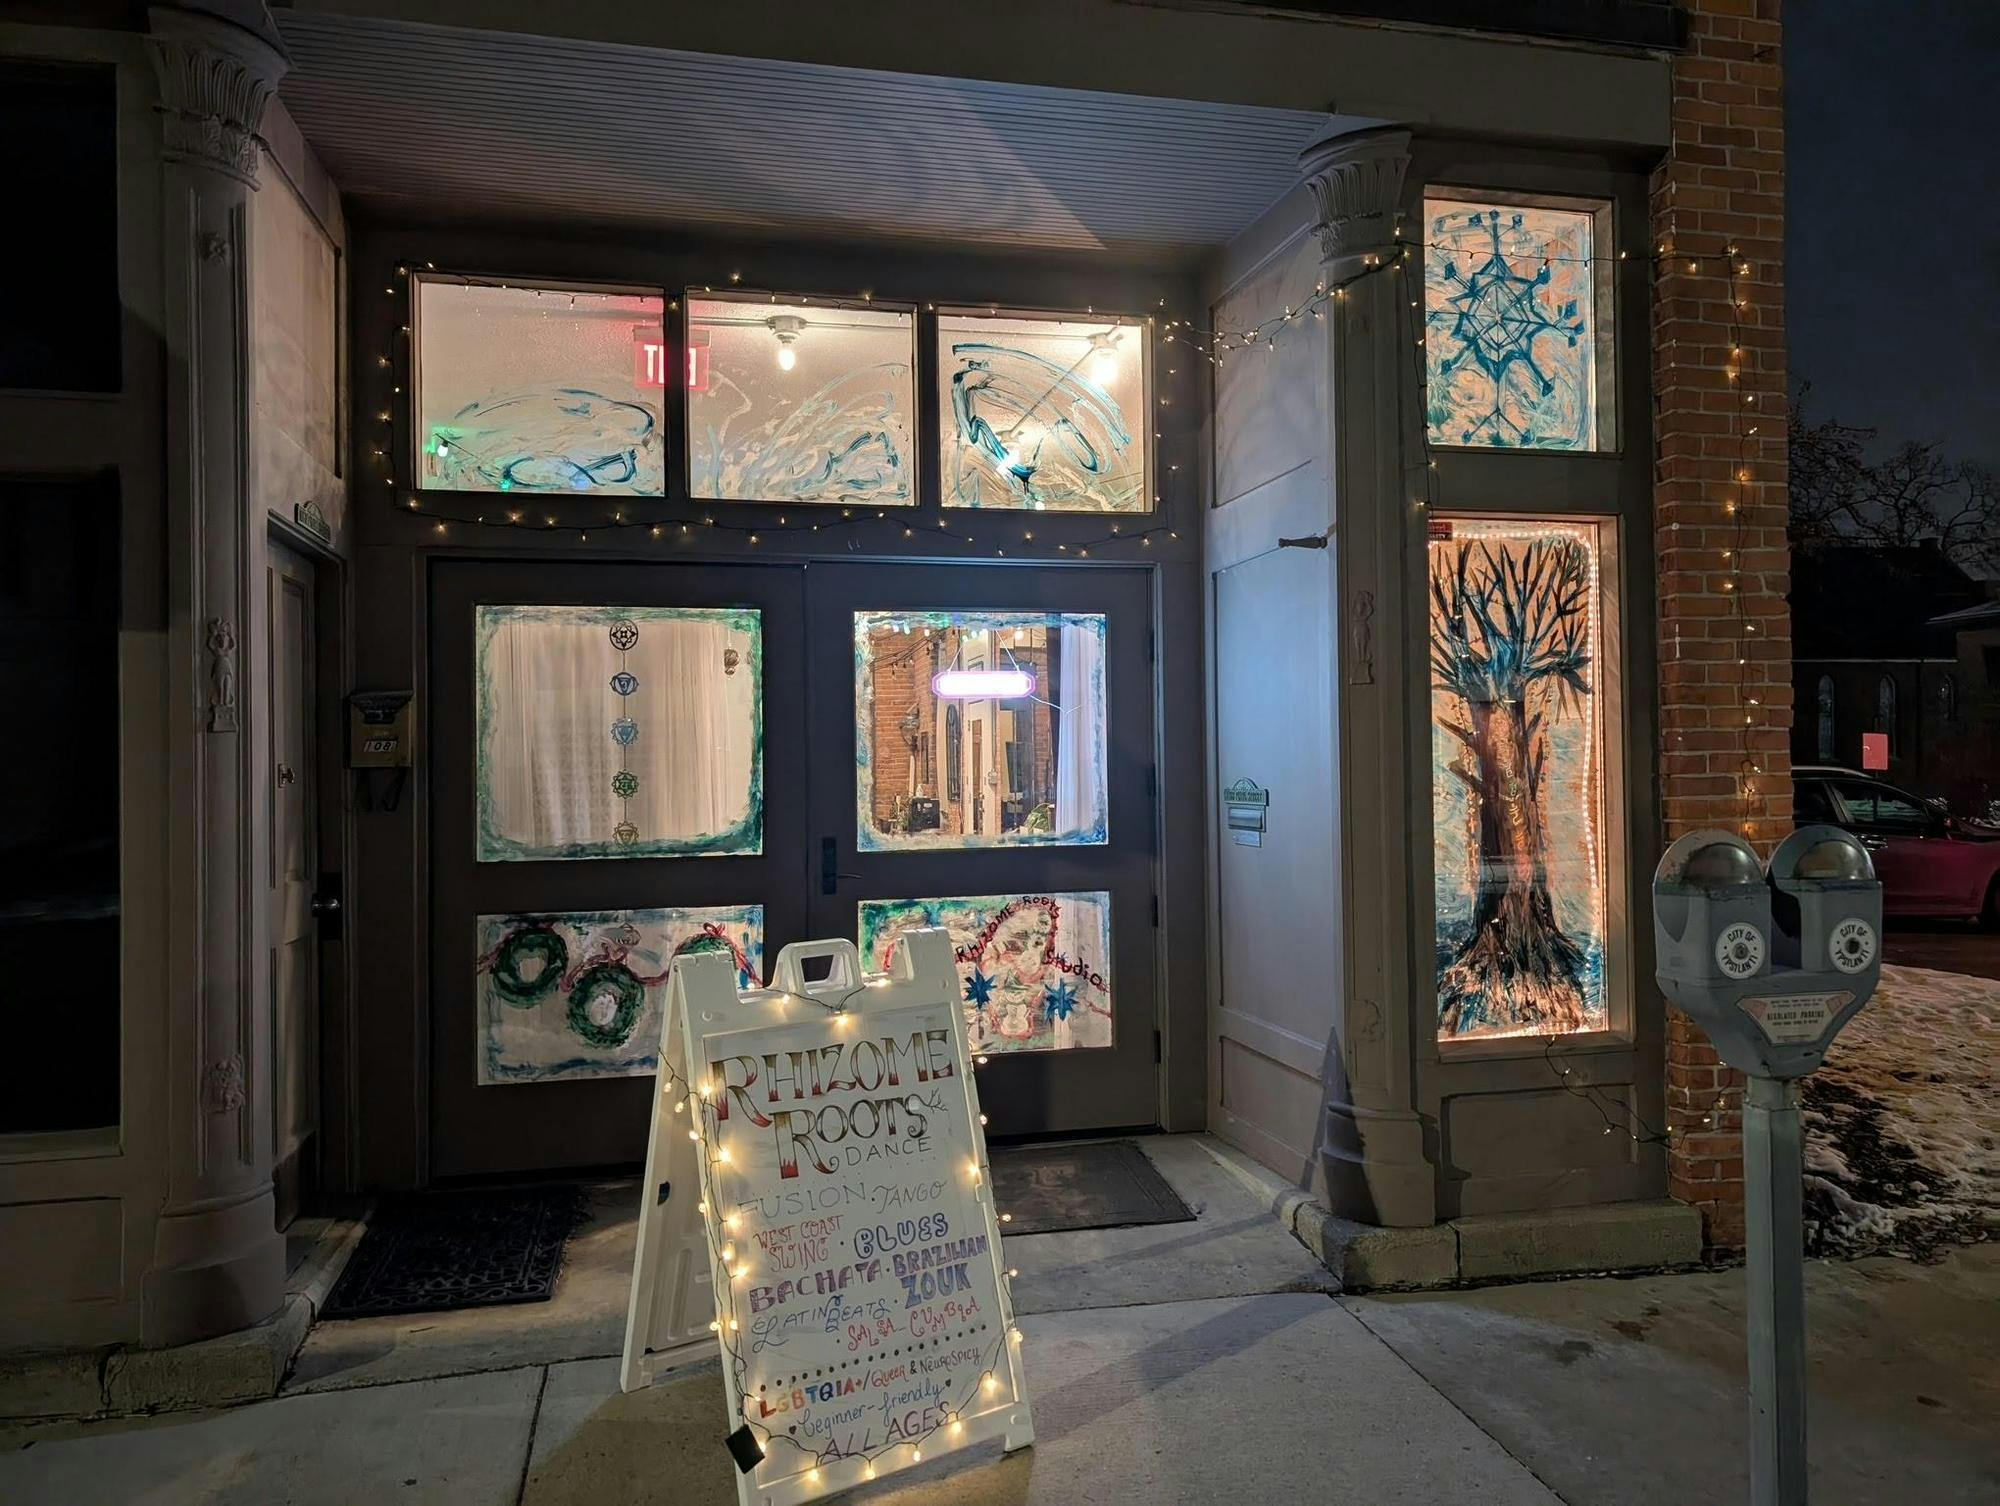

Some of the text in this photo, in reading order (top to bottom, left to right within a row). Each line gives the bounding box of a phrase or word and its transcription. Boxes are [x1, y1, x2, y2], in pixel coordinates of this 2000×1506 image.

[1727, 929, 1756, 942] CITY OF
[1840, 924, 1868, 937] CITY OF
[711, 1029, 954, 1128] RHIZOME
[769, 1093, 929, 1179] ROOTS
[847, 1137, 931, 1166] DANCE
[737, 1181, 947, 1219] FUSION TANGO
[753, 1215, 843, 1250] WEST COAST
[854, 1213, 948, 1259] BLUES
[749, 1235, 987, 1313] BACHATA BRAZILIAN
[769, 1238, 828, 1272] SWING
[901, 1263, 971, 1309] ZOUK
[751, 1294, 891, 1353] LATIN BEATS
[910, 1360, 918, 1375] &
[820, 1402, 950, 1462] ALL AGES
